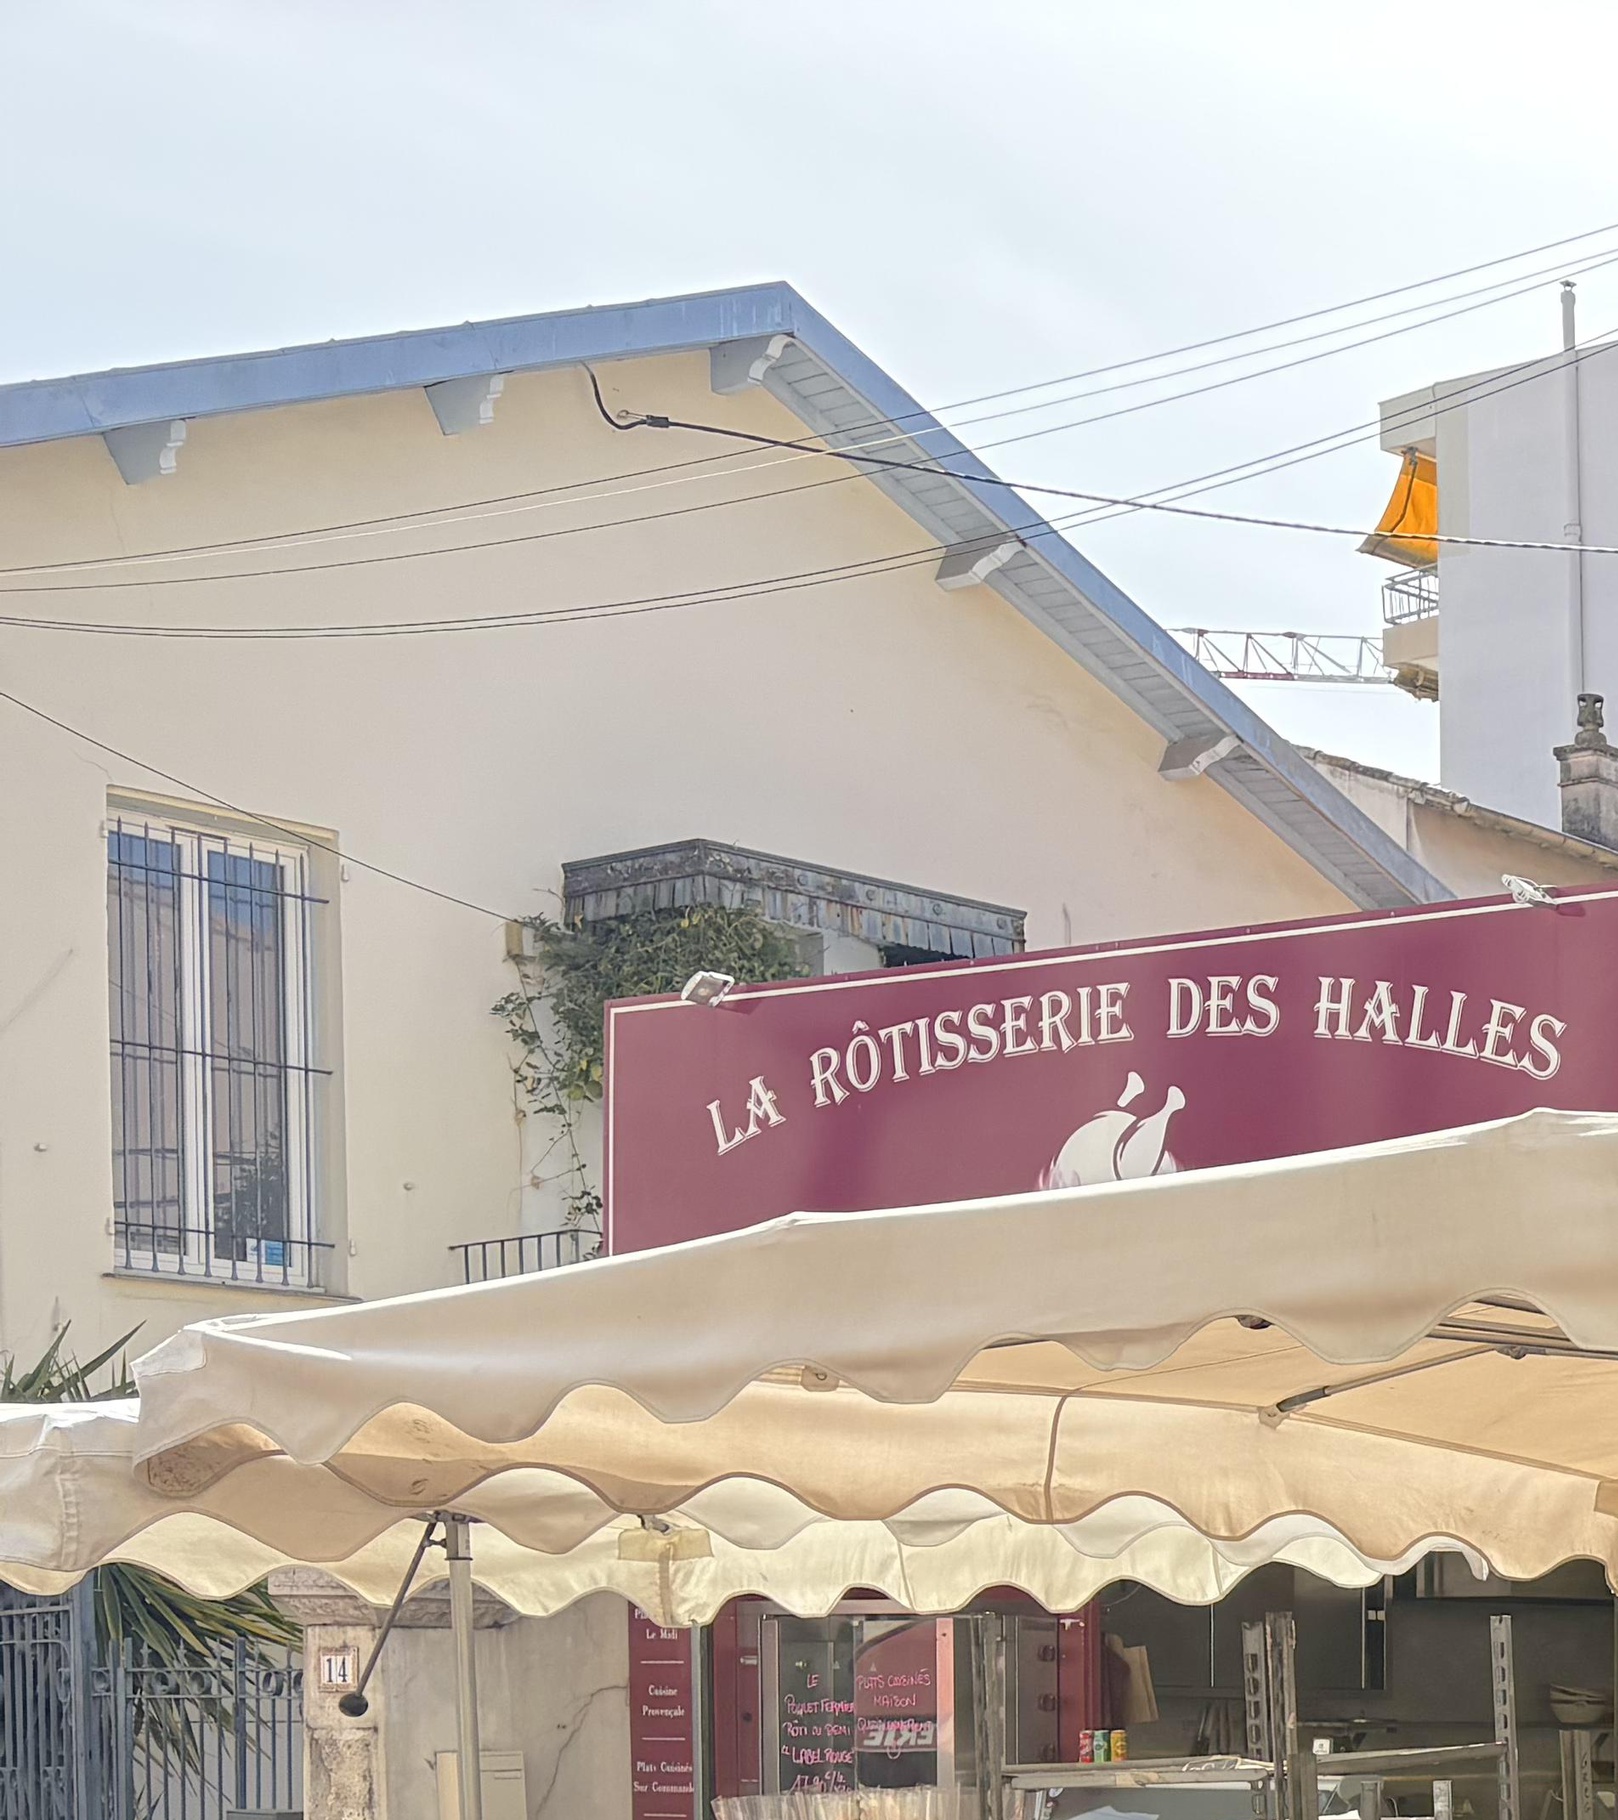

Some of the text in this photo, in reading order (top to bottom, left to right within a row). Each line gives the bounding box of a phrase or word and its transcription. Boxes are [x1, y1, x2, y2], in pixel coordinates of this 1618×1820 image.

[706, 974, 1567, 1156] LA RÔTISSERIE DES HALLES
[326, 1656, 349, 1683] 14
